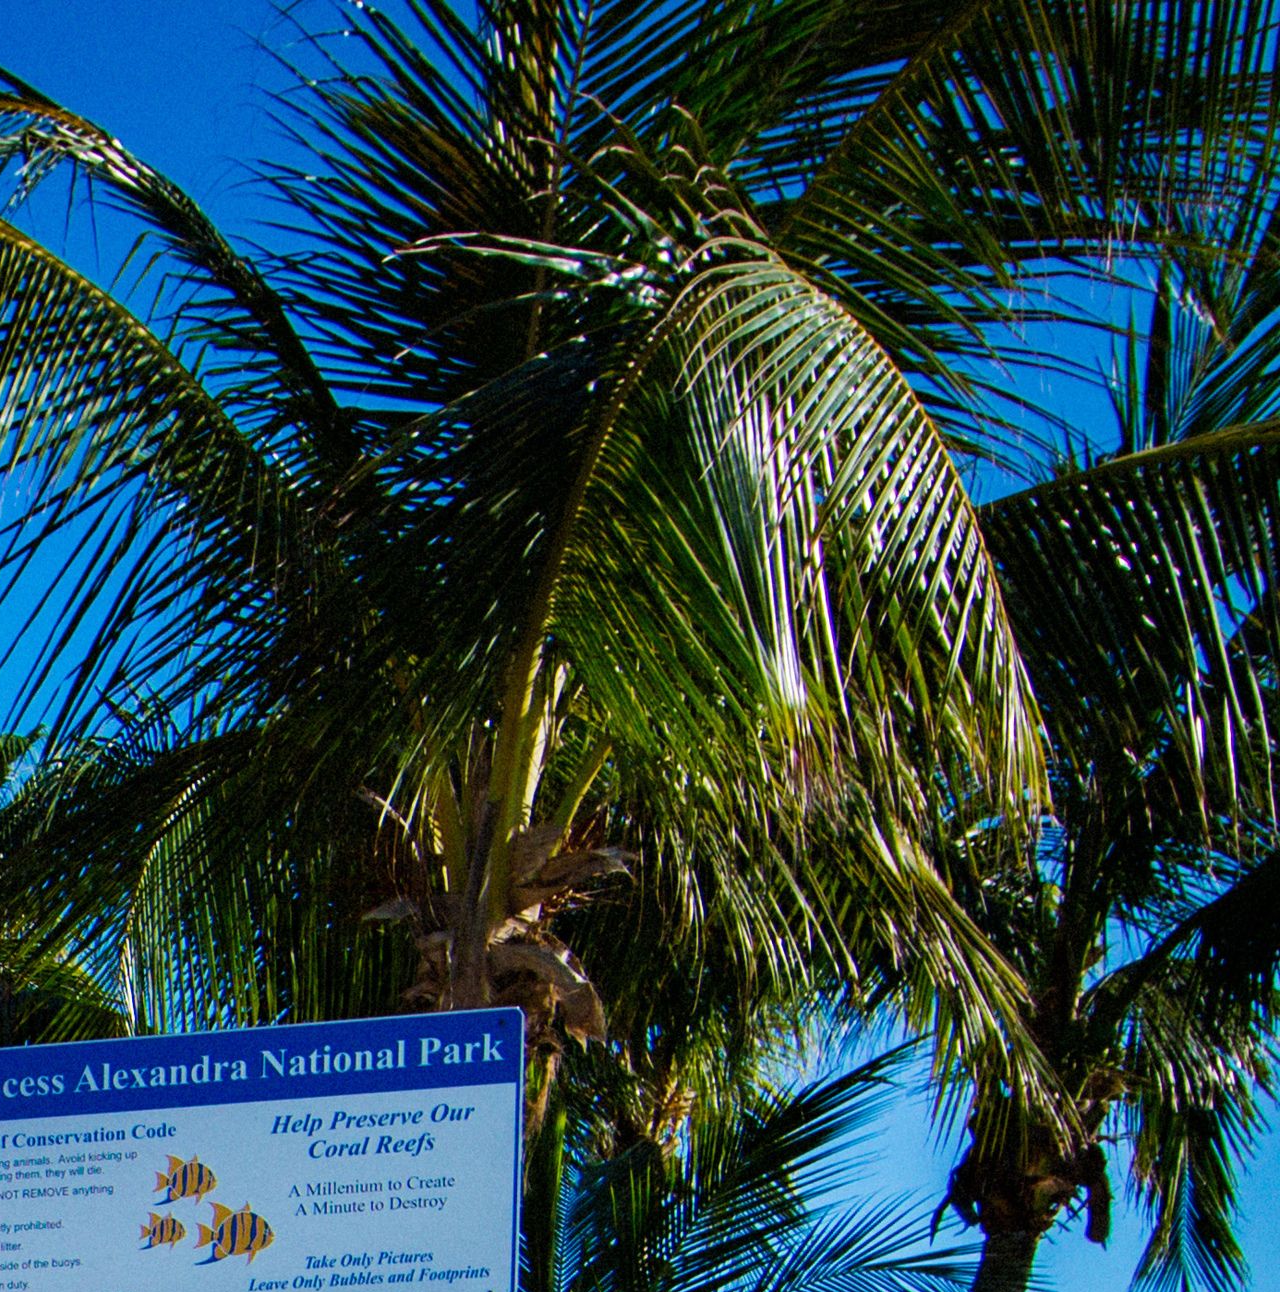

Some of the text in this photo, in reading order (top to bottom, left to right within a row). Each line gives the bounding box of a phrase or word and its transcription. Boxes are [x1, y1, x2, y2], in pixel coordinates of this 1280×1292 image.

[74, 1055, 248, 1093] Alexandra
[260, 1039, 406, 1079] National
[417, 1033, 504, 1067] Park
[271, 1103, 475, 1137] Help Preserve Our
[12, 1127, 126, 1148] Conservation
[131, 1123, 177, 1139] Code
[308, 1132, 436, 1160] Coral Reefs
[22, 1188, 69, 1199] REMOVE
[72, 1184, 114, 1197] anything
[288, 1175, 456, 1198] A Millenium to Create
[295, 1196, 448, 1217] A Minute to Destroy
[22, 1261, 32, 1270] of
[34, 1260, 49, 1269] the
[305, 1251, 434, 1270] Take Only Pictures
[7, 1280, 30, 1292] duty.
[249, 1266, 490, 1292] Leave Only Bubbles and Footprints
